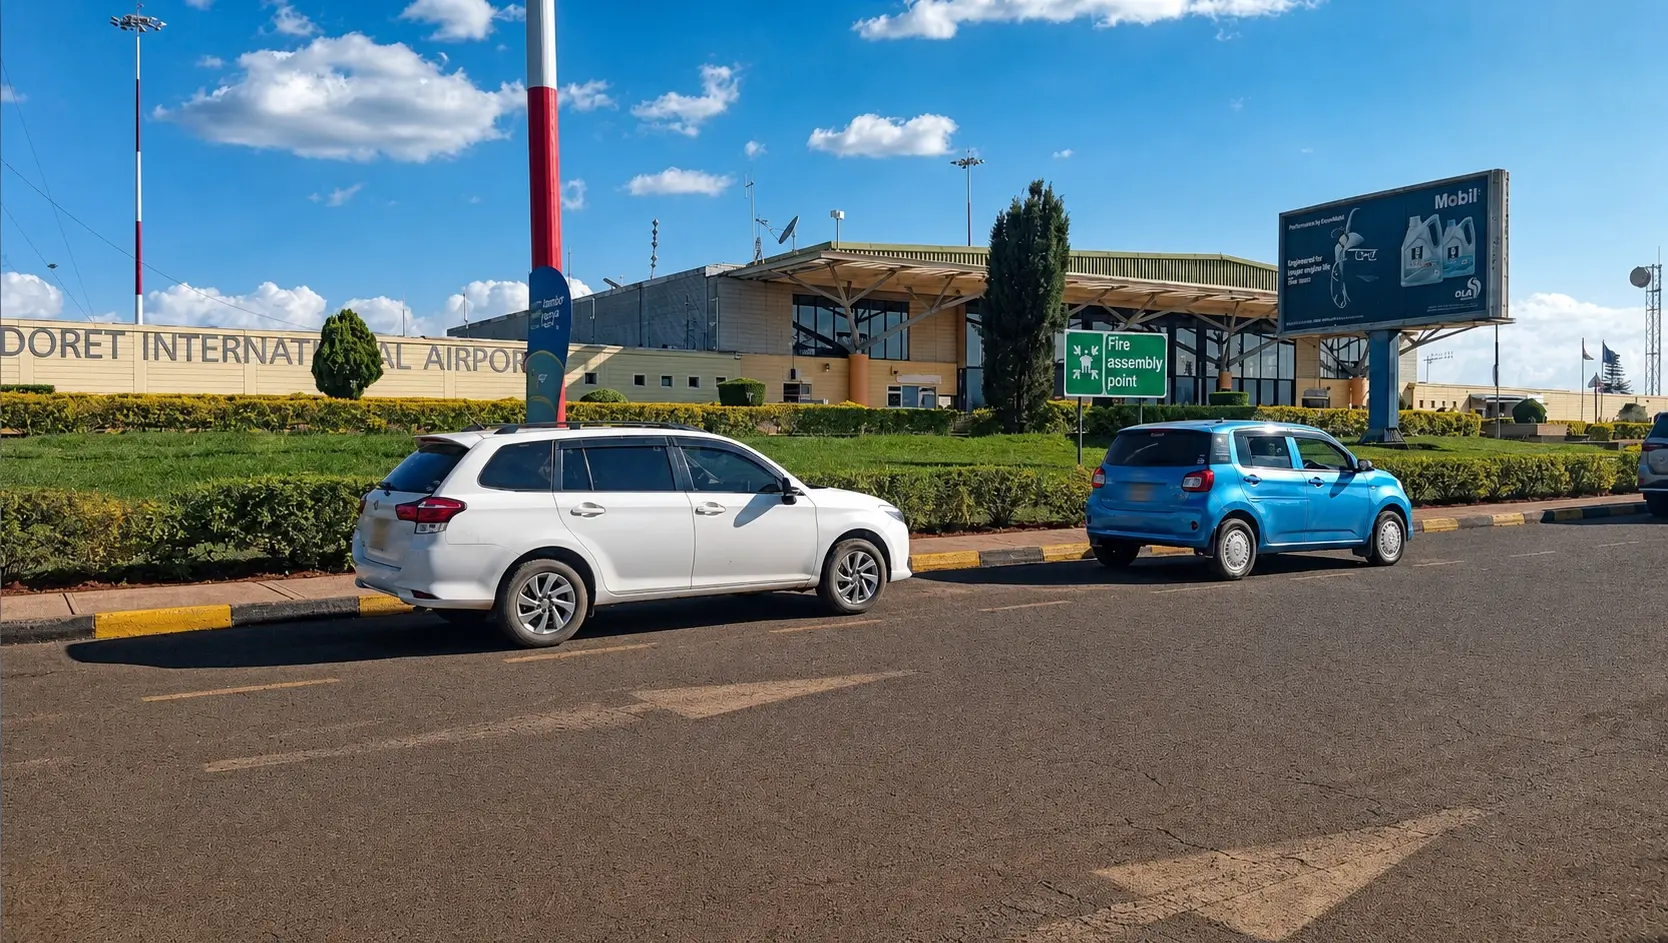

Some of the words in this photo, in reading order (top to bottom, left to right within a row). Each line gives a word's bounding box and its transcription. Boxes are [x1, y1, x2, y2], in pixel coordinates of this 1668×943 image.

[1435, 187, 1478, 210] Mobil
[1454, 289, 1472, 298] OLA
[0, 325, 126, 359] DORET
[142, 331, 412, 370] INTERNATAL
[423, 344, 528, 373] AIRPOR
[1108, 336, 1130, 351] Fire
[1107, 356, 1163, 373] assembly
[1107, 374, 1138, 390] point
